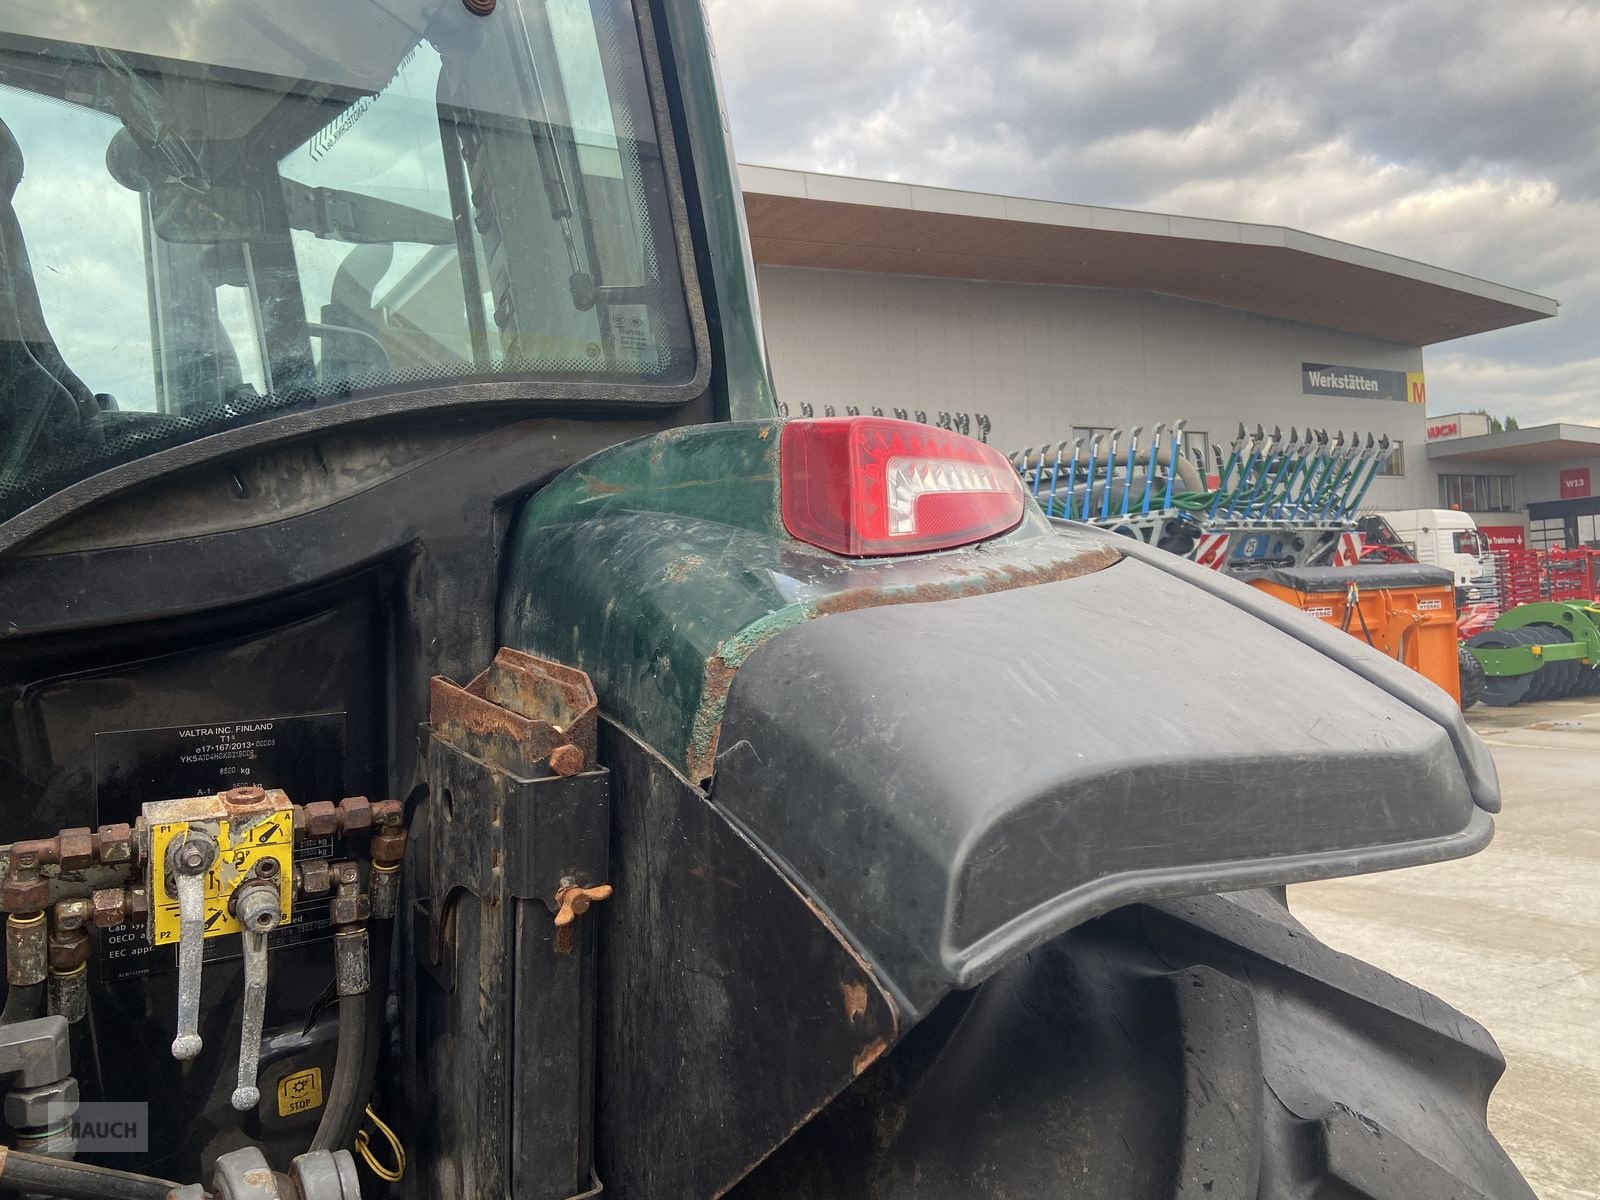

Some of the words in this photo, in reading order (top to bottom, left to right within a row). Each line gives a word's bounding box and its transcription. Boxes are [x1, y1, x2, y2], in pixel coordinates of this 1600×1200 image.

[1308, 370, 1378, 392] Werkstätten
[1566, 478, 1585, 487] W13
[179, 728, 213, 738] VALTRA
[215, 726, 233, 735] INC.
[235, 722, 273, 733] FINLAND
[240, 767, 251, 775] kg
[160, 825, 171, 834] P1
[108, 933, 135, 944] OECD
[160, 931, 171, 939] P2
[109, 949, 127, 958] EEC
[131, 946, 155, 956] appr.
[289, 1099, 310, 1112] STOP
